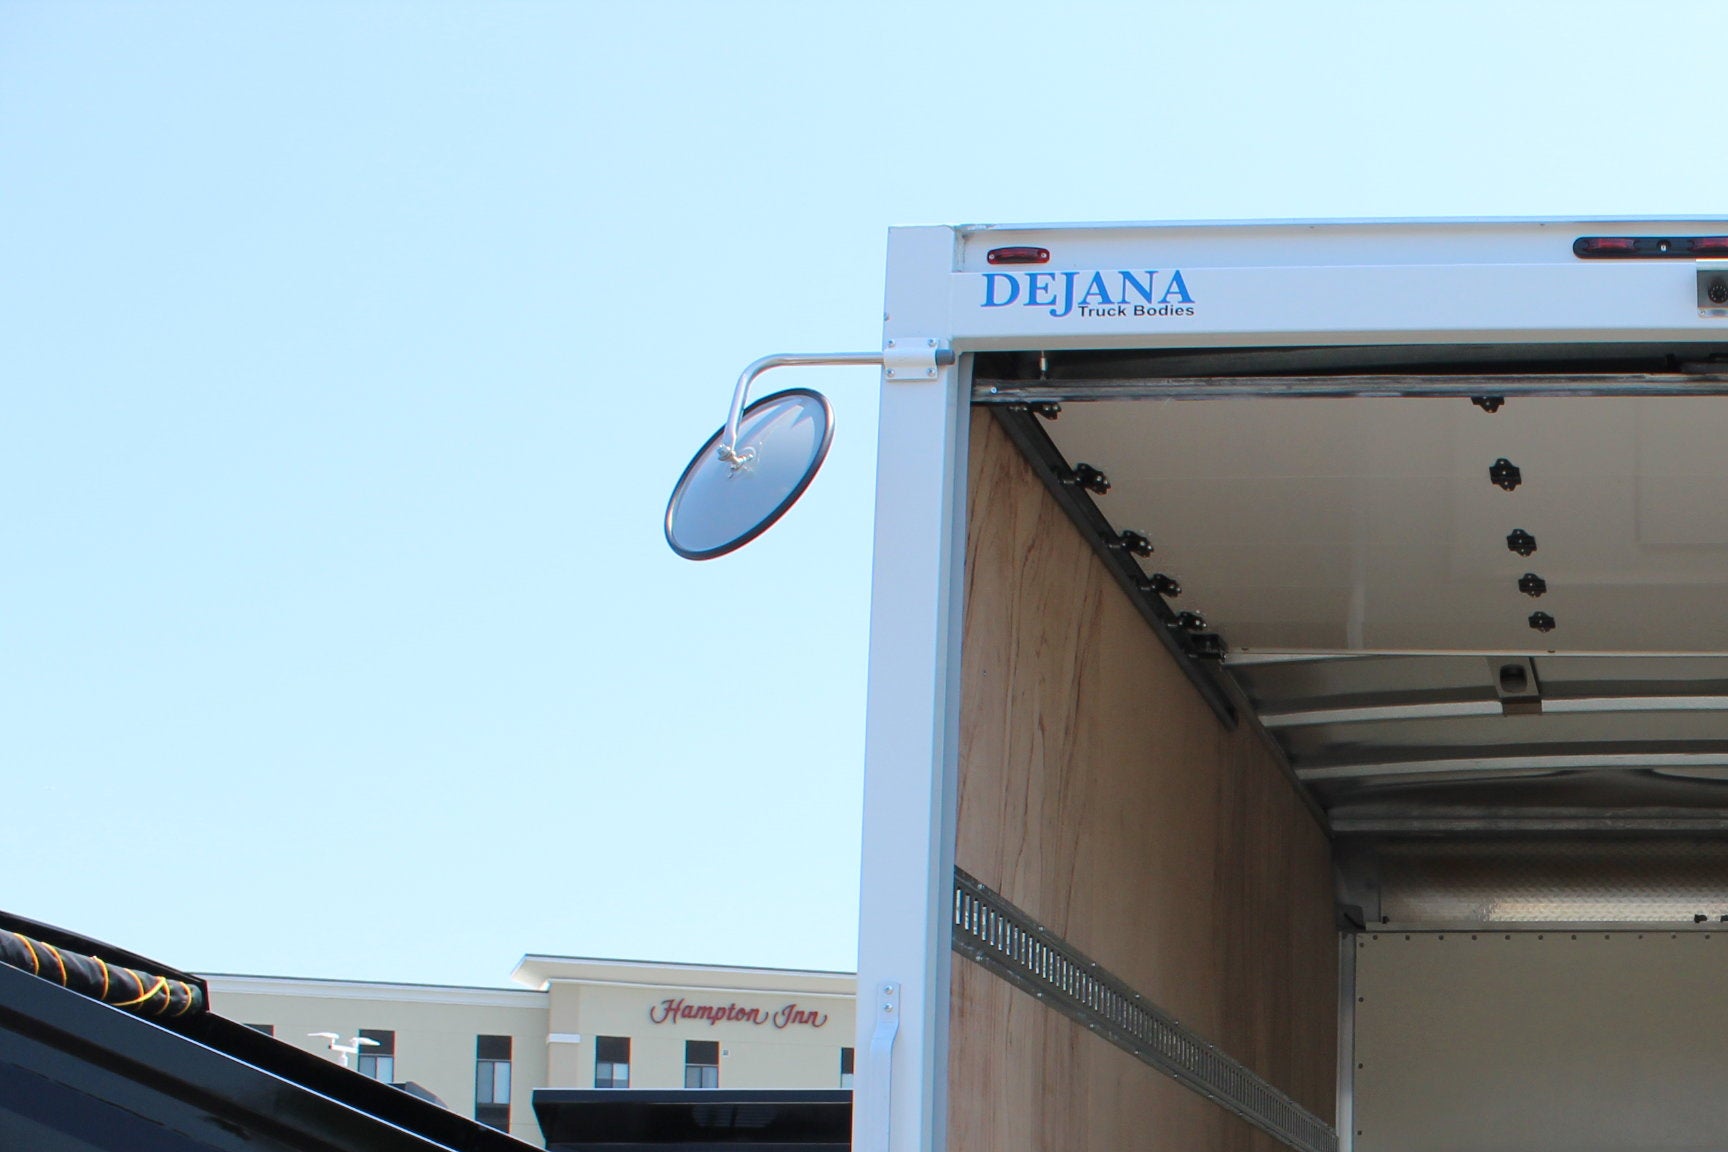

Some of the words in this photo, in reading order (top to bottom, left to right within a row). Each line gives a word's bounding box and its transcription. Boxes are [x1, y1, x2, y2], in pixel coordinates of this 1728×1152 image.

[980, 269, 1196, 317] DEJANA
[1078, 304, 1128, 317] Truck
[1133, 303, 1195, 317] Bodies
[650, 998, 769, 1026] Hampton
[773, 1003, 828, 1029] Inn
